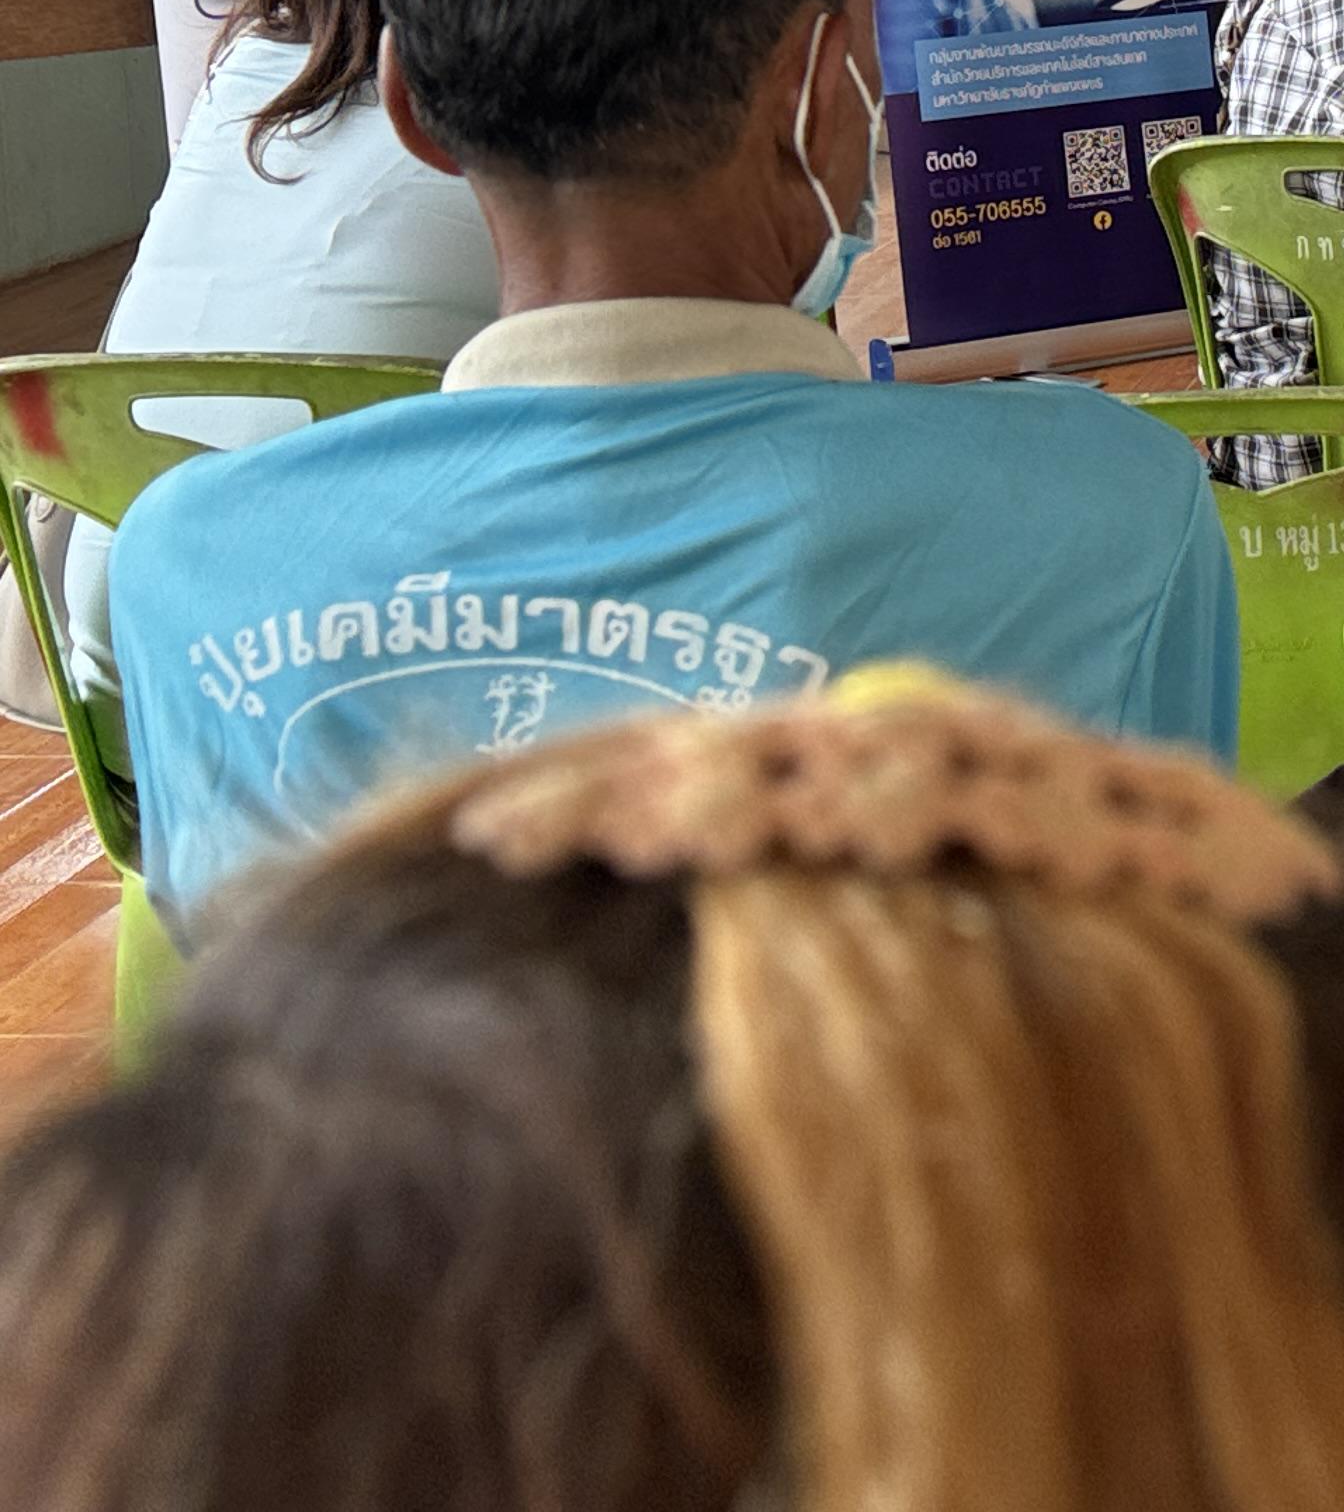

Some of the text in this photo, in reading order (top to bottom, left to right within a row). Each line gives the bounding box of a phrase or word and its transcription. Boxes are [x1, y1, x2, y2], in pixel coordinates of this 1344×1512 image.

[926, 145, 978, 172] ติดต่อ
[928, 166, 1043, 199] CONTACT
[930, 196, 1047, 229] 055-706555
[1296, 236, 1310, 260] ก
[1317, 237, 1334, 261] ท
[1239, 524, 1263, 558] บ
[1275, 513, 1320, 571] หมู่
[189, 570, 832, 719] ปุ๋ยเคมีมาตรฐา
